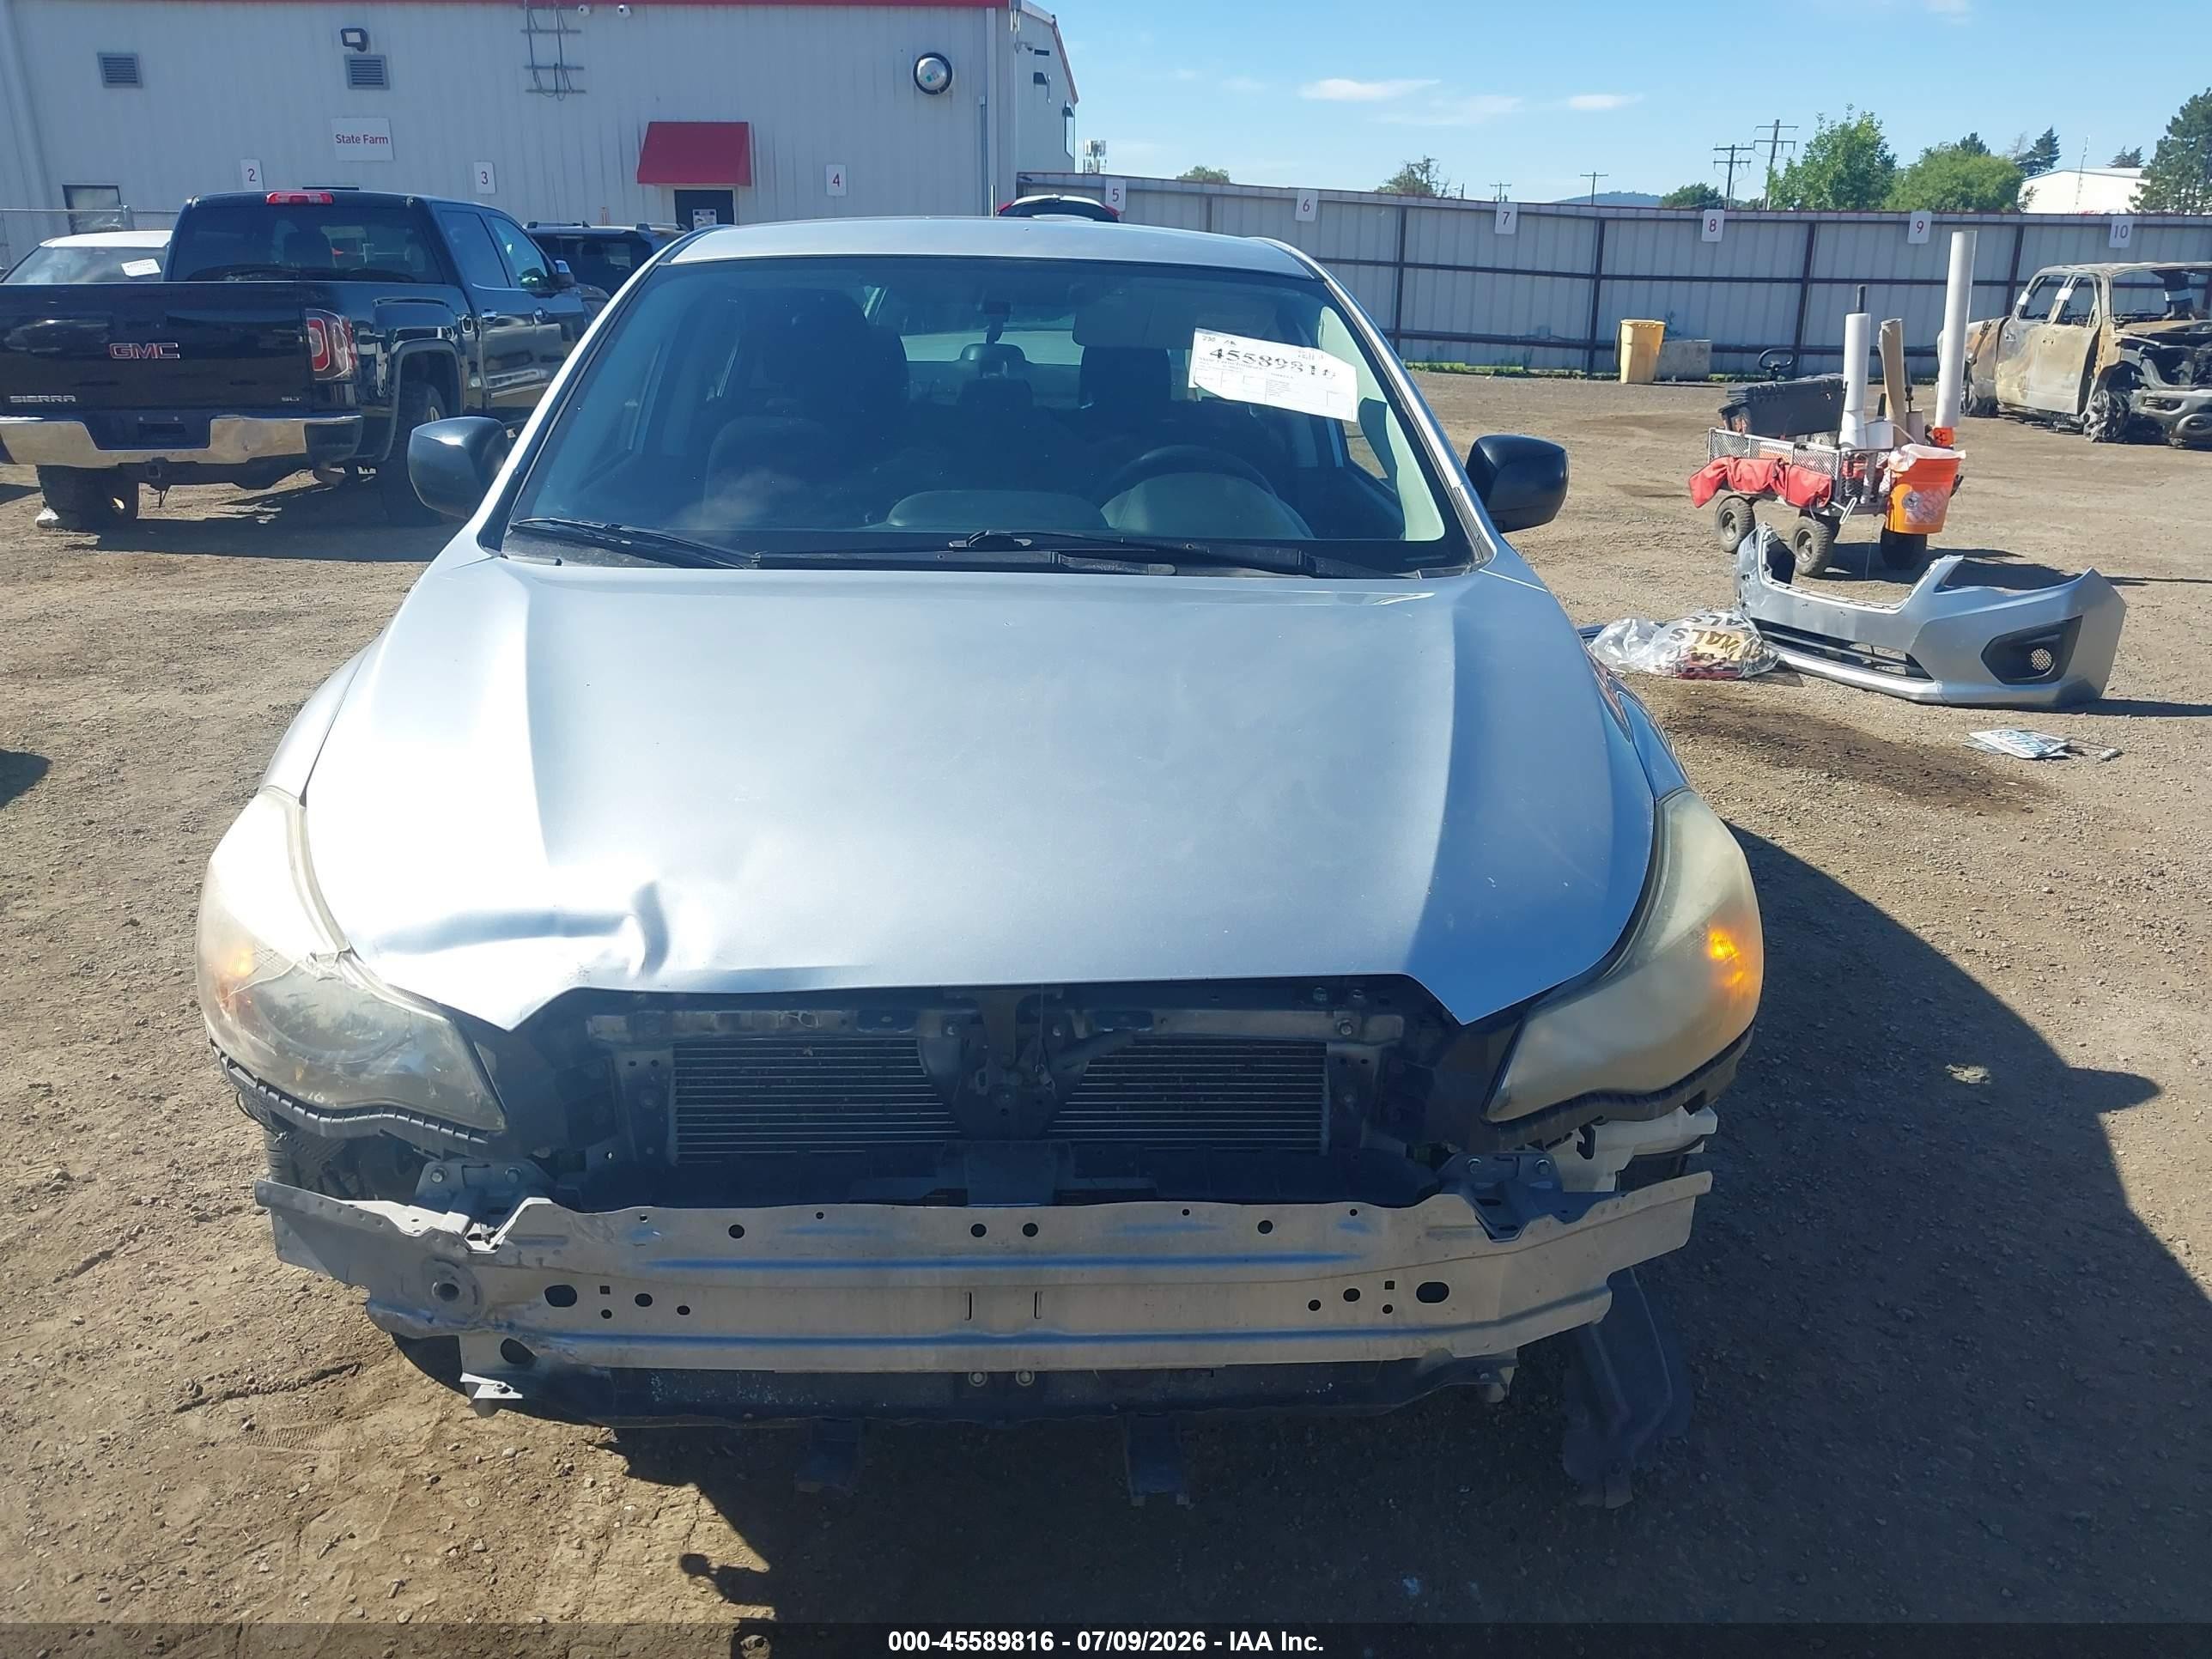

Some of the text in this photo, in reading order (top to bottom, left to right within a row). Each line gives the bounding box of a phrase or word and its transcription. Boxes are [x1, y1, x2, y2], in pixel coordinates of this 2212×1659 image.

[336, 133, 389, 144] State Farm
[247, 167, 257, 181] 2
[480, 171, 489, 185] 3
[832, 173, 841, 187] 4
[1112, 188, 1120, 202] 5
[1302, 198, 1310, 212] 6
[1503, 211, 1511, 225] 7
[1709, 218, 1717, 233] 8
[1916, 220, 1924, 234] 9
[2114, 224, 2129, 239] 10
[109, 343, 180, 359] GMC
[9, 395, 76, 404] SIERRA
